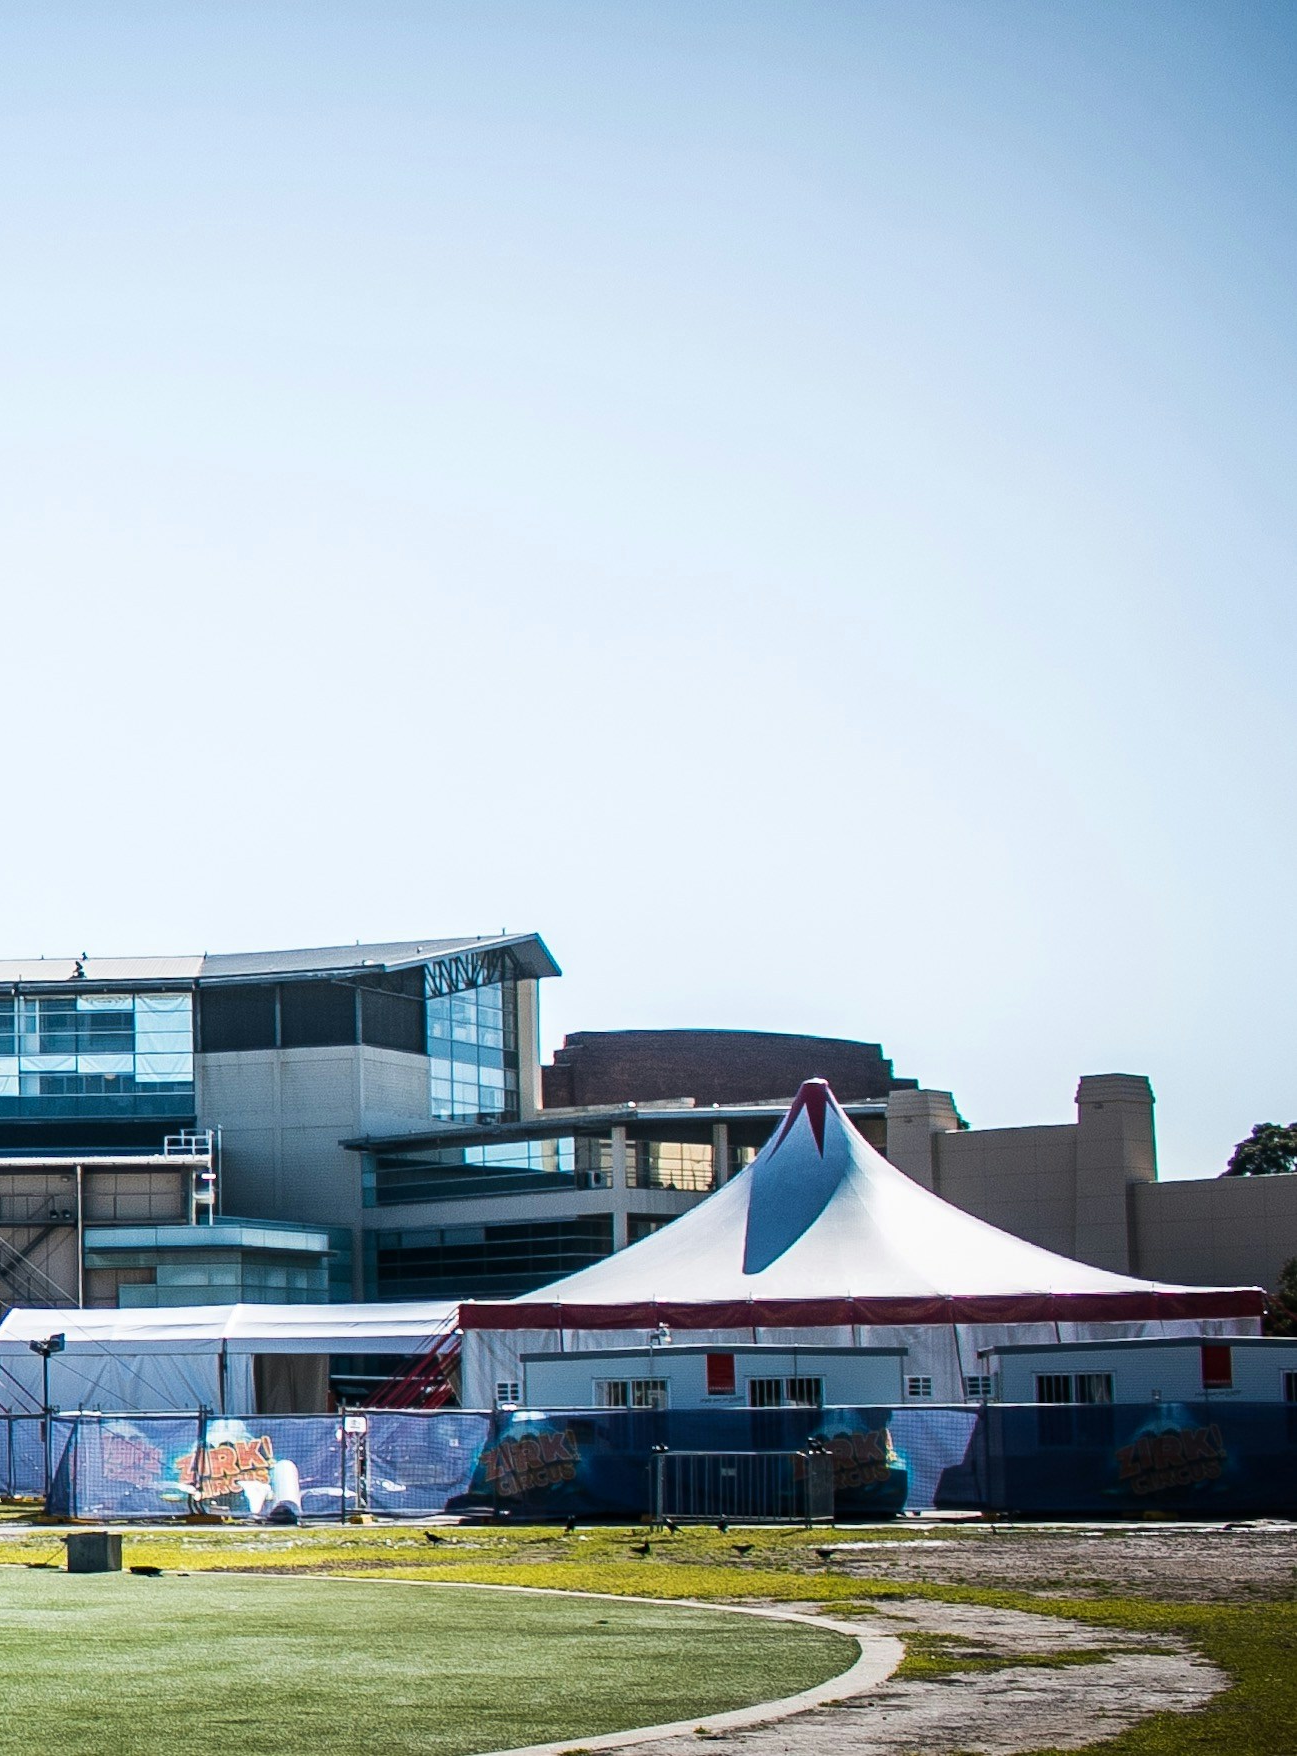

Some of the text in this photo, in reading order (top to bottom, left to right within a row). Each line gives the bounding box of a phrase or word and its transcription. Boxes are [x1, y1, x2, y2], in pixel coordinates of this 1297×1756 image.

[175, 1435, 275, 1485] ZIRK!
[479, 1429, 581, 1482] ZIRK!
[1115, 1423, 1227, 1480] ZIRK!
[497, 1462, 576, 1496] CIRCUS
[1132, 1459, 1222, 1495] CIRCUS
